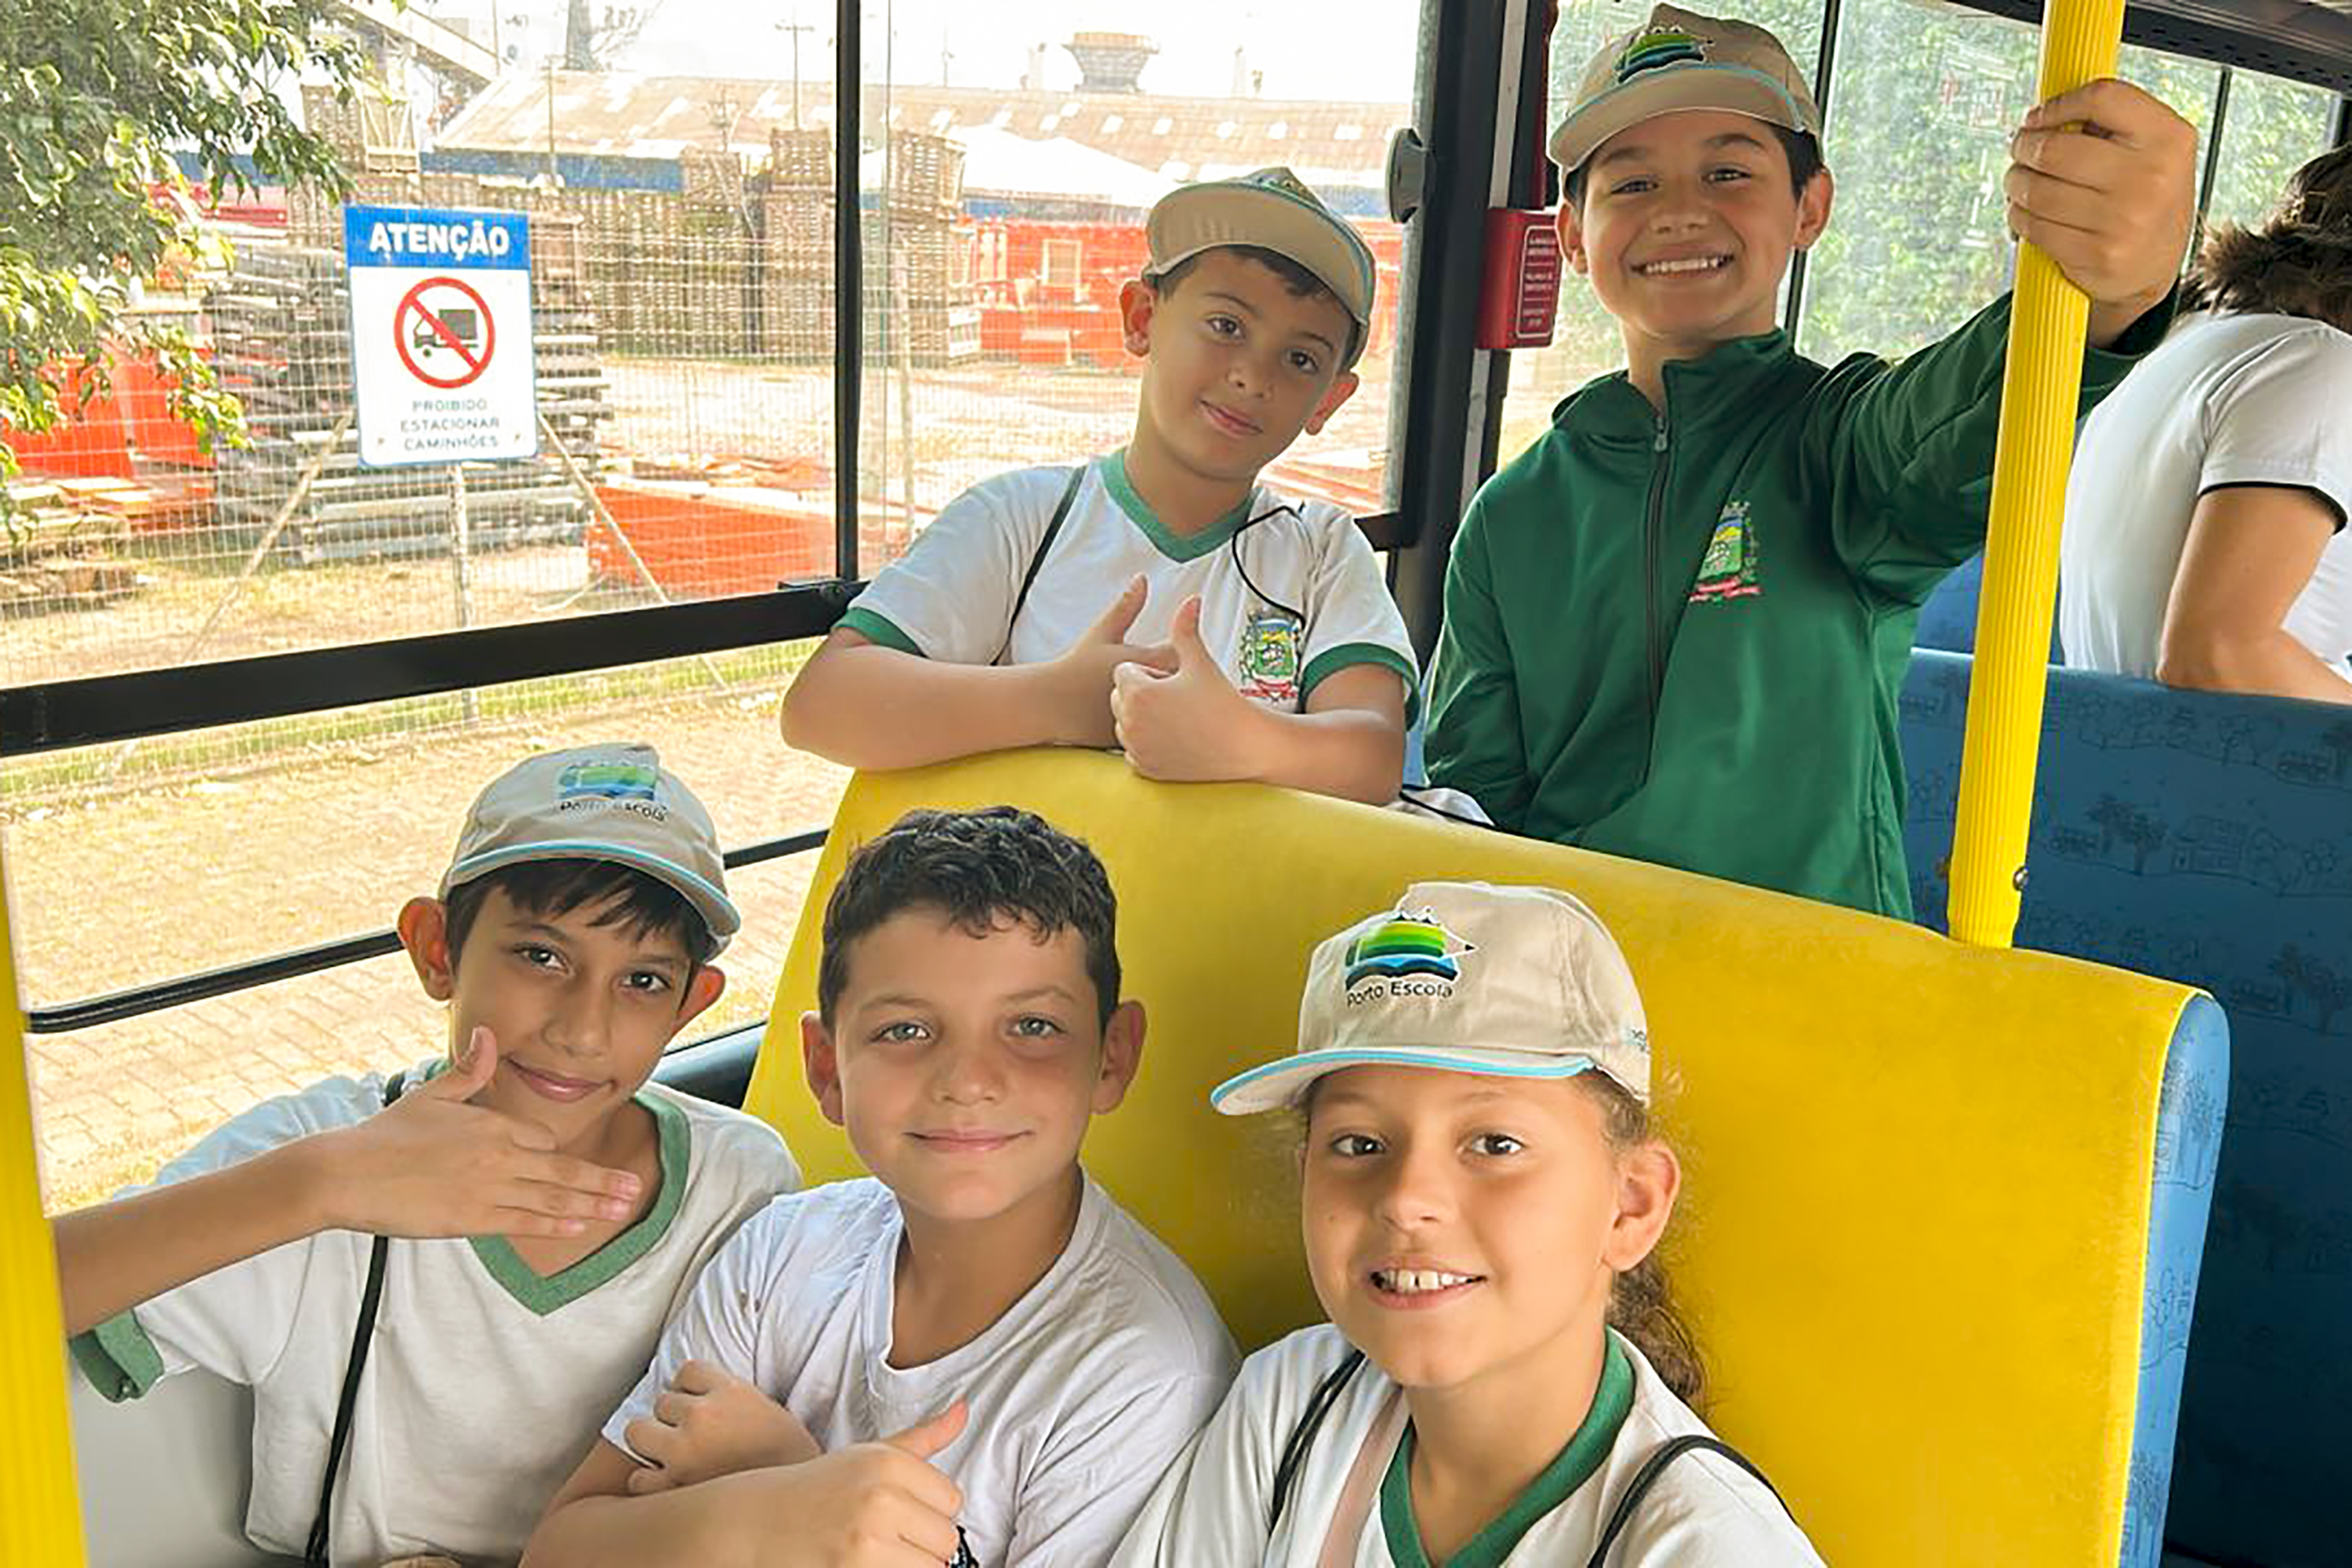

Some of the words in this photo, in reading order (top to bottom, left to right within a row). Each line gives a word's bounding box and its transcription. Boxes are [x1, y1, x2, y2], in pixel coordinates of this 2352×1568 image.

[369, 220, 510, 260] ATENÇÃO
[412, 399, 487, 412] PROIBIDO
[401, 417, 499, 432] ESTACIONAR
[405, 434, 498, 451] CAMINHÕES
[1347, 985, 1384, 1007] Porto
[1391, 981, 1453, 998] Escola
